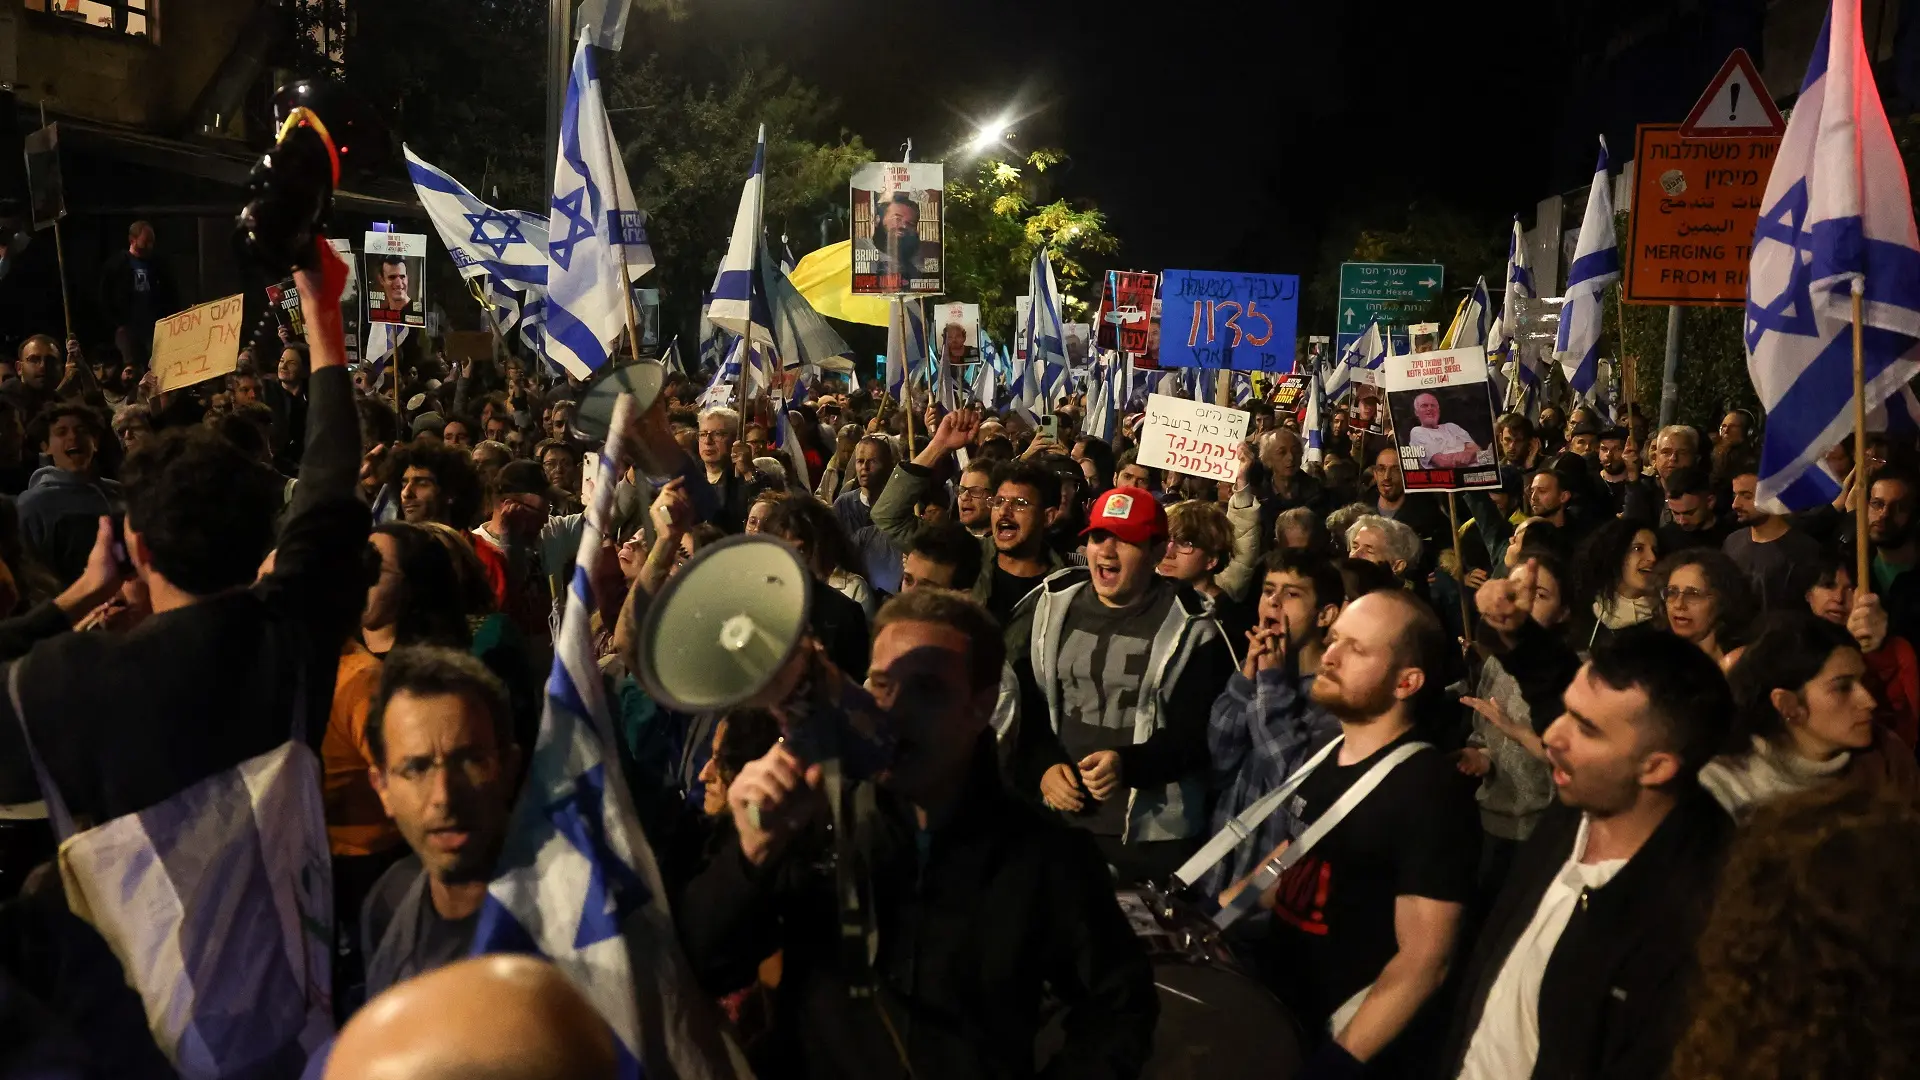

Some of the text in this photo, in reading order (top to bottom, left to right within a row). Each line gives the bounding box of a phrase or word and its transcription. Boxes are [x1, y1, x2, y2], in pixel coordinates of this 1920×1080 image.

[1650, 139, 1740, 160] משתלבות
[1705, 169, 1758, 190] מימין
[1677, 219, 1734, 237] اليمين
[855, 249, 879, 261] BRING
[1644, 245, 1725, 260] MERGING
[855, 262, 871, 273] HIM
[1360, 267, 1407, 276] שערי חסד
[1660, 269, 1716, 285] FROM
[210, 298, 241, 321] העם
[204, 322, 239, 351] את
[1407, 364, 1462, 378] KEITH SAMUEL SIEGEL
[1195, 408, 1243, 424] גם היום
[1150, 411, 1239, 439] אני כאן בשביל
[1165, 433, 1237, 460] להתנגד
[1400, 445, 1426, 458] BRING
[1165, 451, 1234, 479] למלחמה
[1402, 458, 1420, 470] HIM
